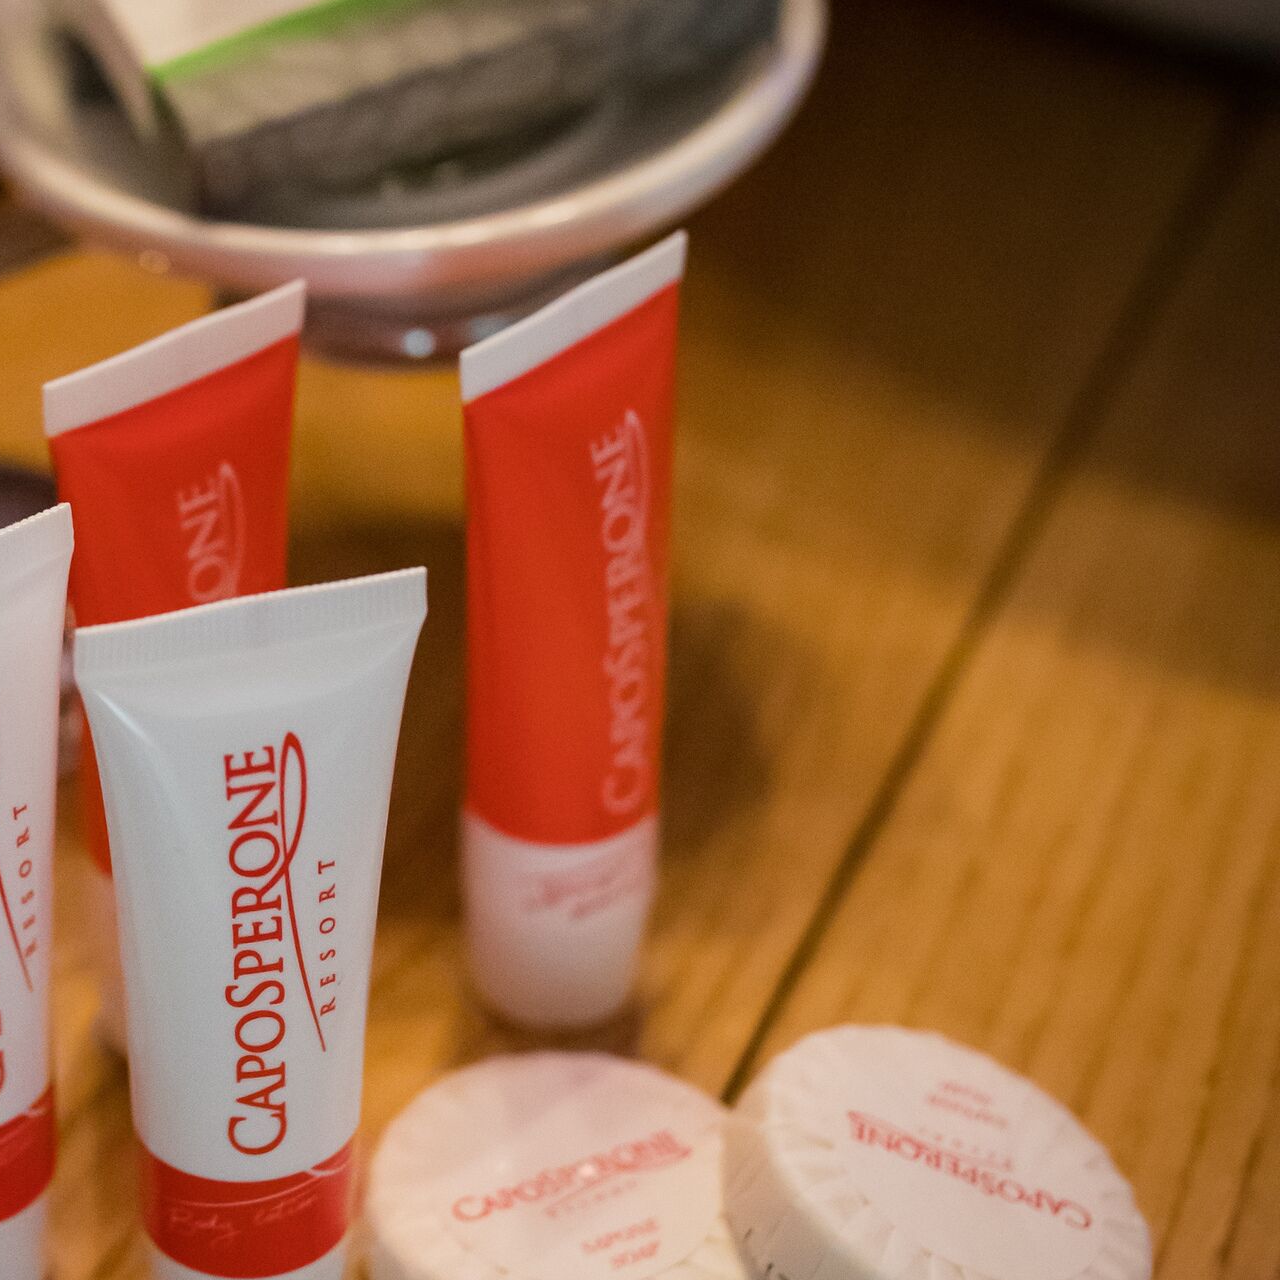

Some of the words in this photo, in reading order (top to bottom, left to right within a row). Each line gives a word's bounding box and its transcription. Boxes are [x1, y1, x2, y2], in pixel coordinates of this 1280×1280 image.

[589, 411, 649, 814] CAPOSPERONE
[13, 803, 38, 959] RESORT
[224, 733, 306, 1156] CAPOSPERONE
[317, 857, 337, 1017] RESORT
[848, 1112, 1093, 1231] CAPOSPERONE
